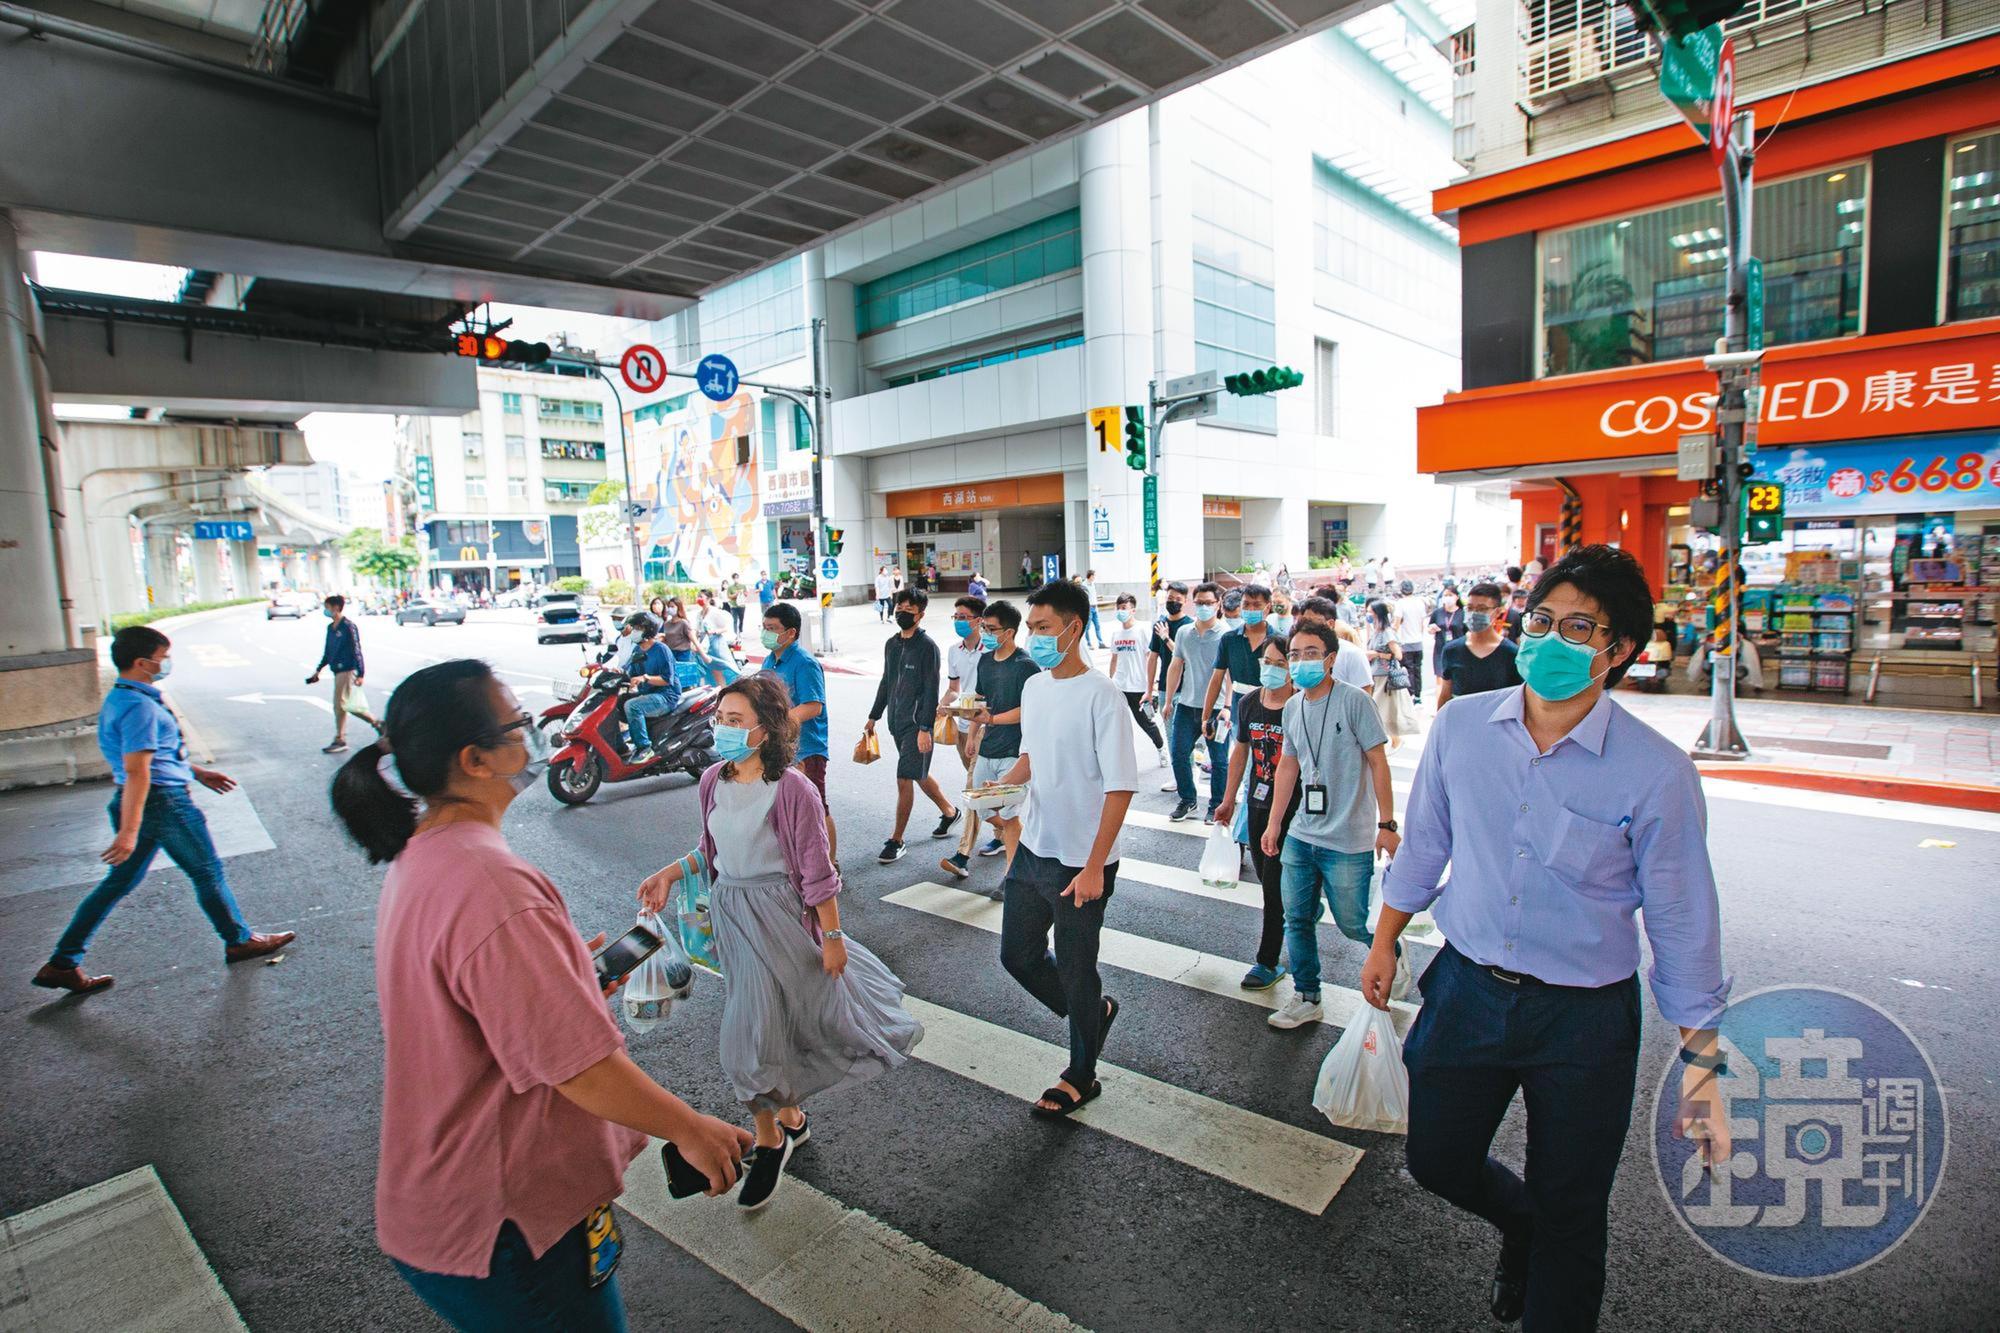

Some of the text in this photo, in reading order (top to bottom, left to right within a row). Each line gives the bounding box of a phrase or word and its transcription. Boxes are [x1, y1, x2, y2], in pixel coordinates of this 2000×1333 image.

[458, 334, 478, 356] 30
[1094, 420, 1106, 452] 1
[1867, 452, 1986, 494] $668
[1750, 486, 1780, 511] 23
